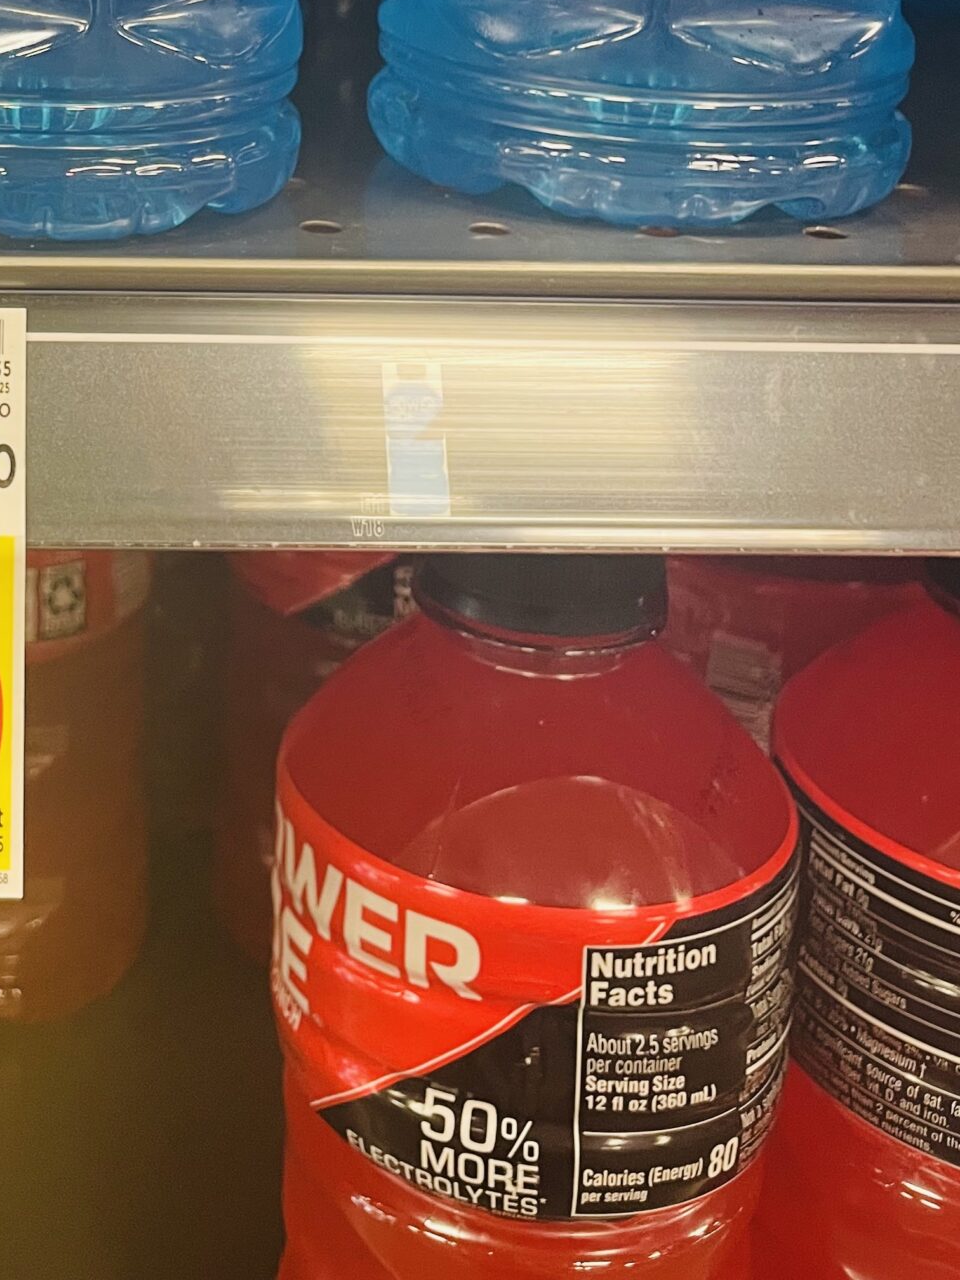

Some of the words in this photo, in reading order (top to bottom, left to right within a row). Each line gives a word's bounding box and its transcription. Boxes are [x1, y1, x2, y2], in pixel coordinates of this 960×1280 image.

[590, 944, 716, 978] Nutrition
[590, 981, 673, 1006] Facts
[587, 1032, 631, 1054] About
[636, 1034, 659, 1054] 2.5
[663, 1028, 718, 1053] servings
[421, 1088, 539, 1162] 50%
[420, 1139, 539, 1195] MORE
[583, 1169, 644, 1187] Calories
[648, 1159, 703, 1187] (Energy)
[708, 1137, 738, 1178] 80
